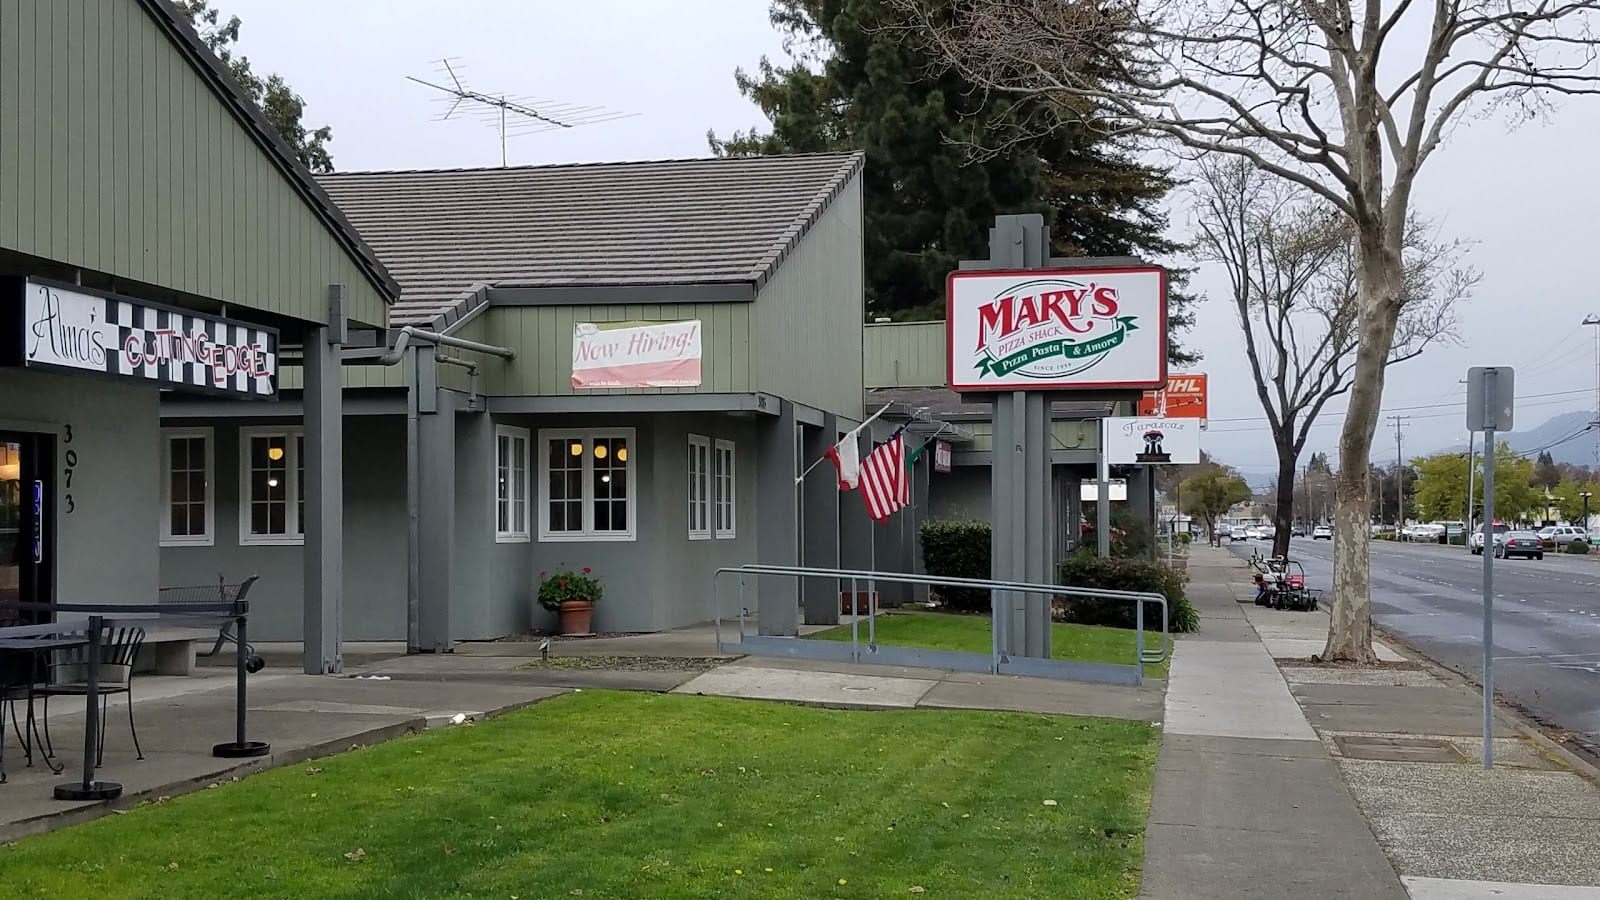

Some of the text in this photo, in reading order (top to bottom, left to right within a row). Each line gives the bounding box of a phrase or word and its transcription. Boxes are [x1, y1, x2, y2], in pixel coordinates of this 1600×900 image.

[29, 286, 106, 366] Alma's
[212, 344, 270, 383] EDGE
[976, 282, 1118, 353] MARY'S
[575, 340, 619, 363] Now
[627, 325, 697, 356] Hiring!
[998, 326, 1063, 356] PIZZA SHACK
[1002, 336, 1118, 370] Pizza Pasta & Amore
[1034, 363, 1054, 371] SINCE
[1167, 379, 1201, 392] IHL
[1122, 421, 1185, 437] Tarascas
[64, 424, 78, 514] 3073
